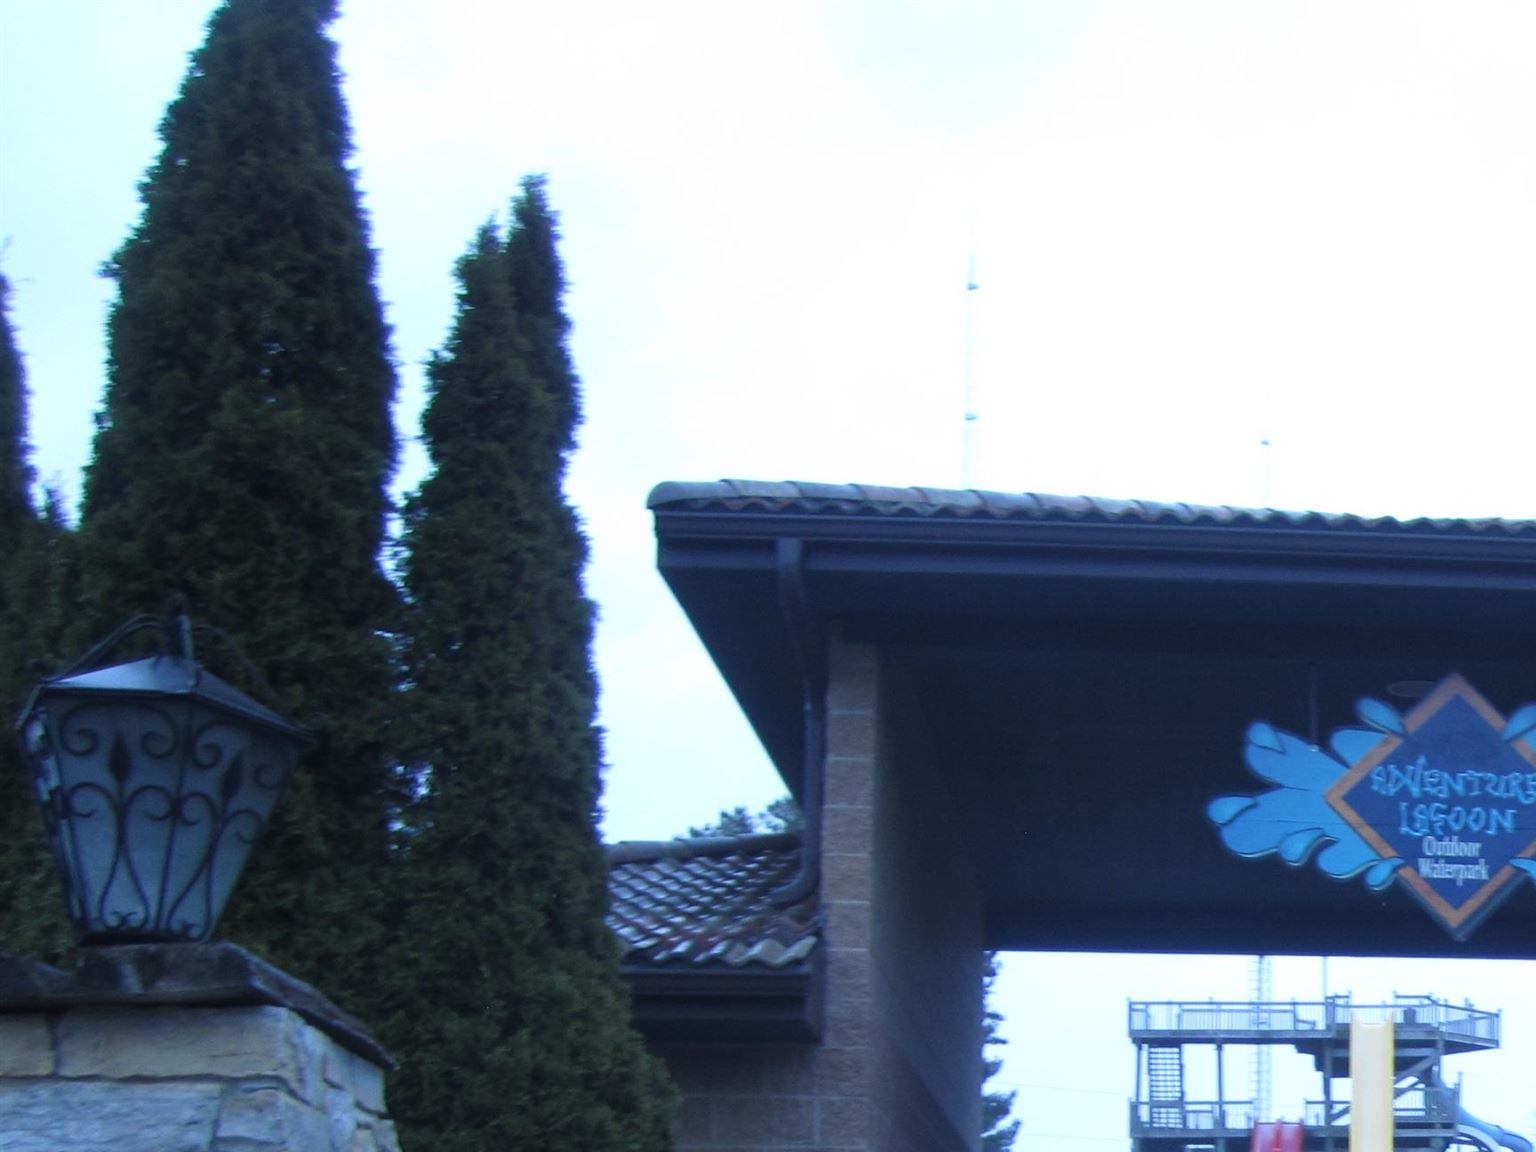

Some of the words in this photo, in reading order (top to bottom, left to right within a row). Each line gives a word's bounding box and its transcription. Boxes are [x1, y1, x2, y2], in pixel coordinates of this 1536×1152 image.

[1399, 802, 1517, 836] LAGOON
[1422, 836, 1481, 857] Outdoor
[1416, 858, 1488, 886] Waterpark
